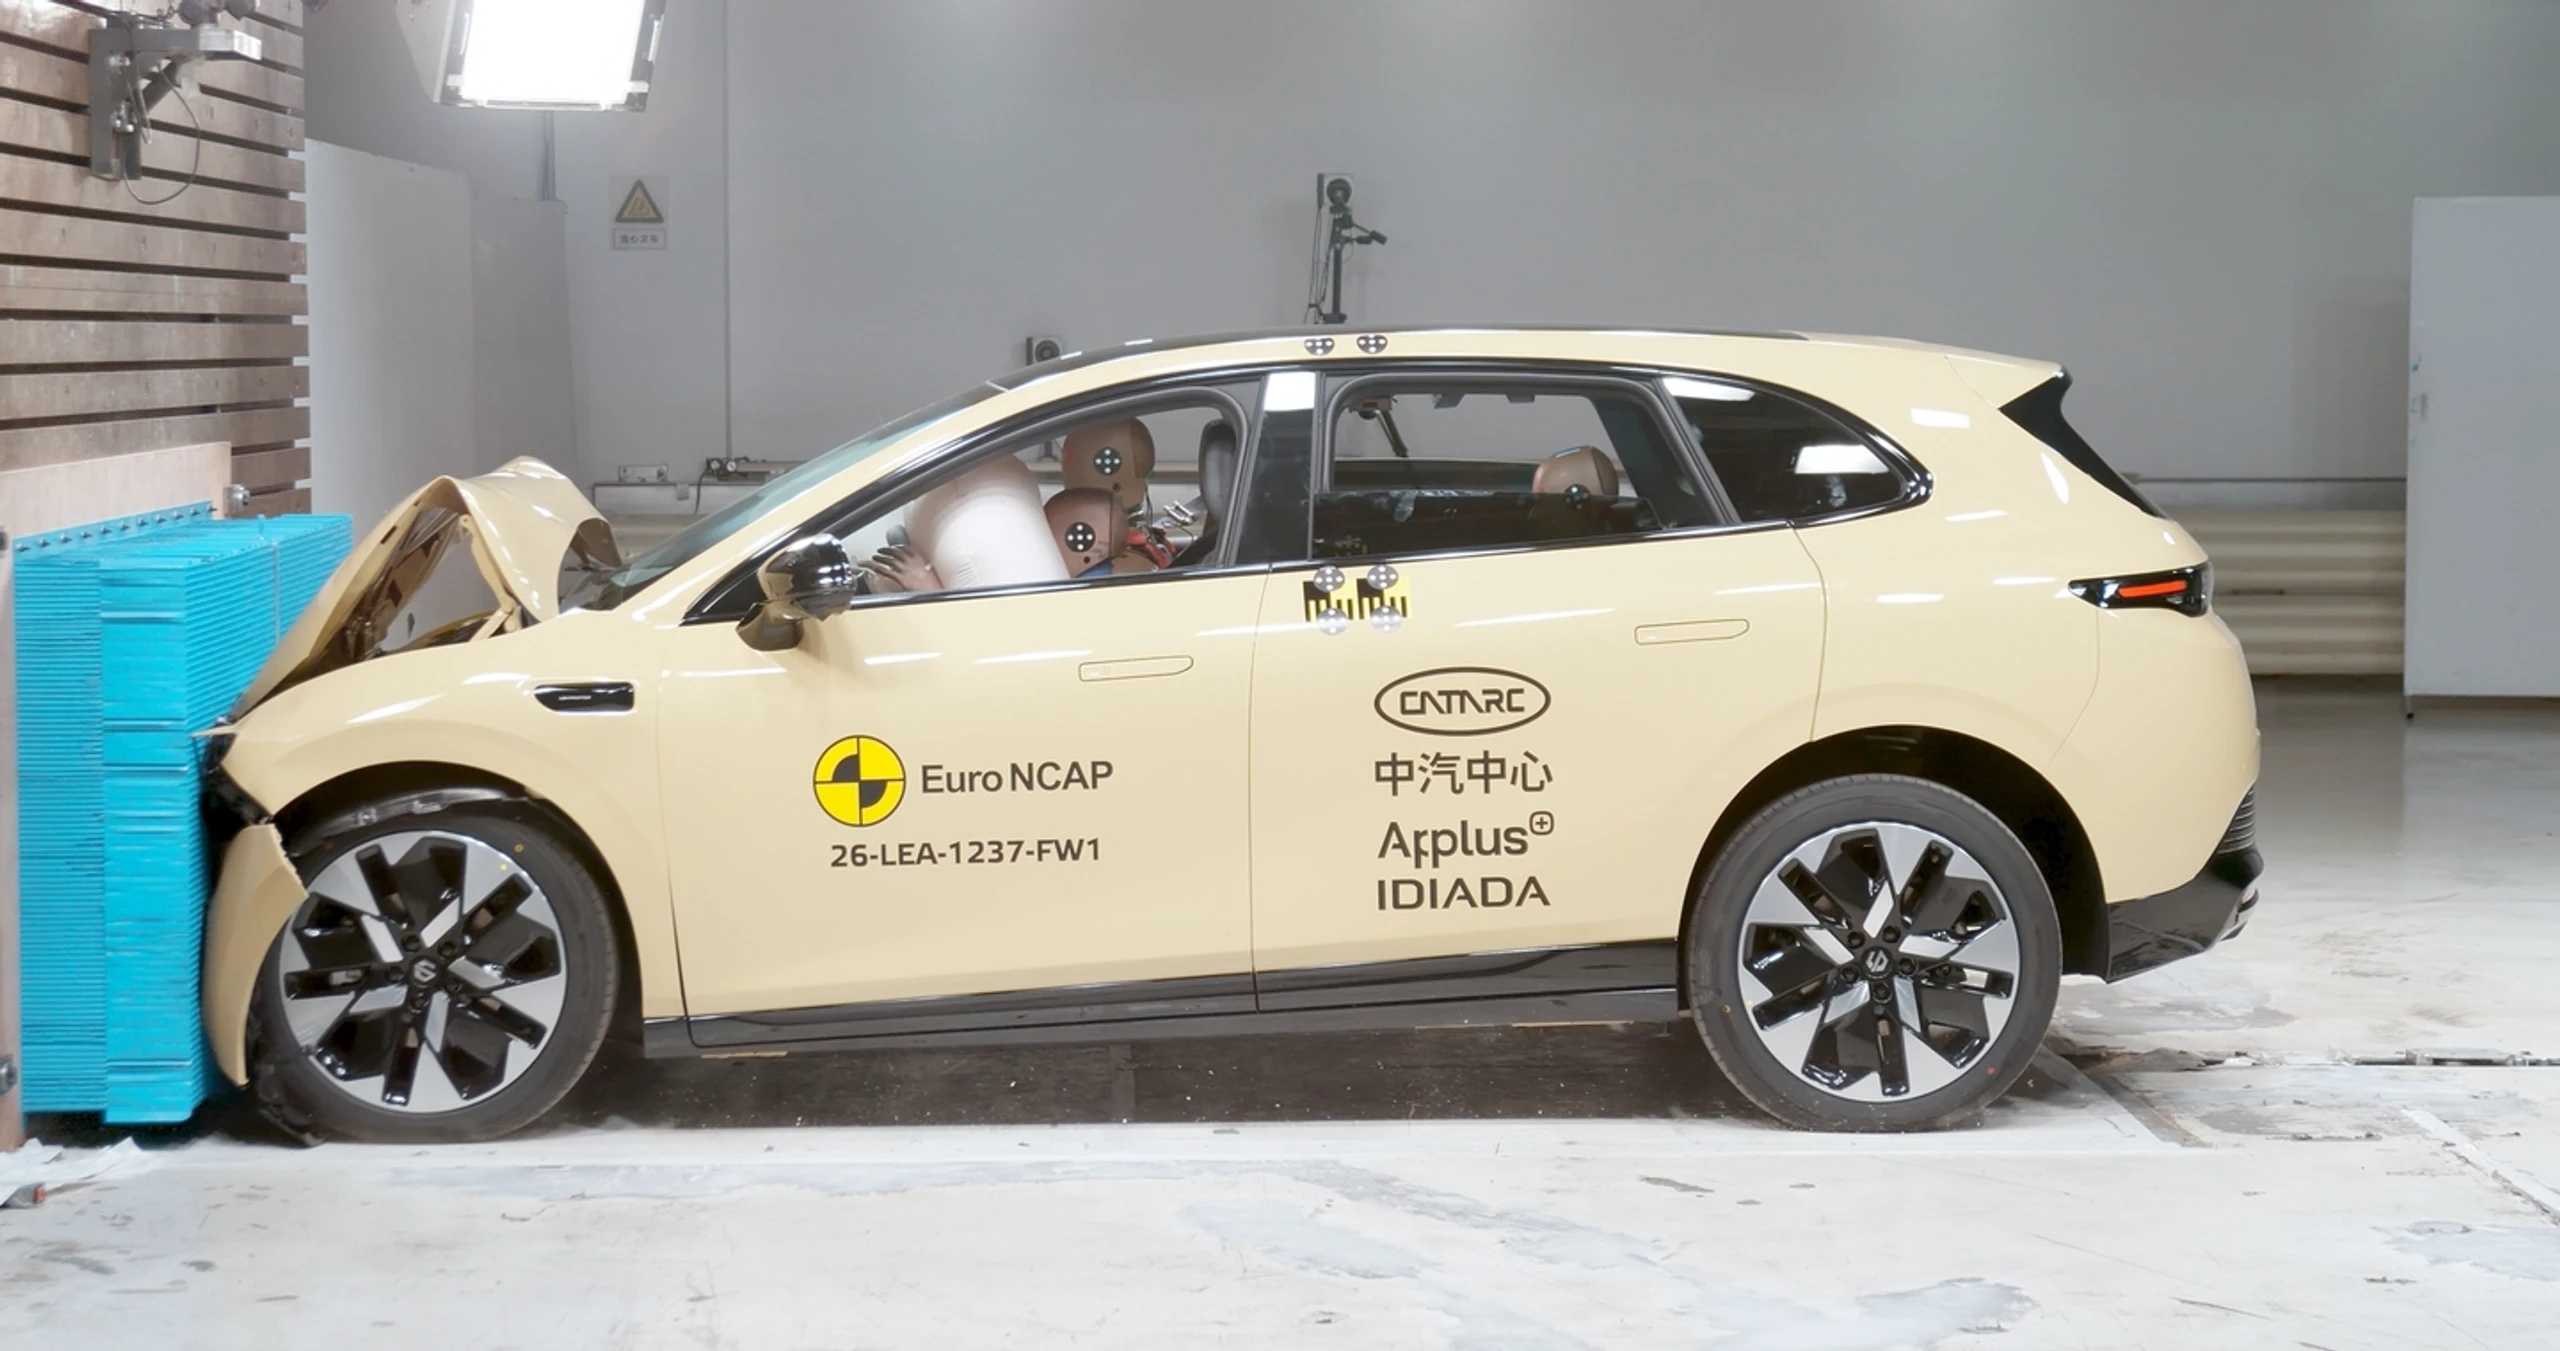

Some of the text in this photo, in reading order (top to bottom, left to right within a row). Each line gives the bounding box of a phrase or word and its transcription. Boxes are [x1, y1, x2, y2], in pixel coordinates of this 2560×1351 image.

[1400, 688, 1525, 715] CATARC
[921, 761, 1113, 793] Euro NCAP
[1375, 750, 1553, 796] 中汽中心
[831, 838, 1099, 867] 26-LEA-1237-FW1
[1378, 876, 1551, 910] IDIADA
